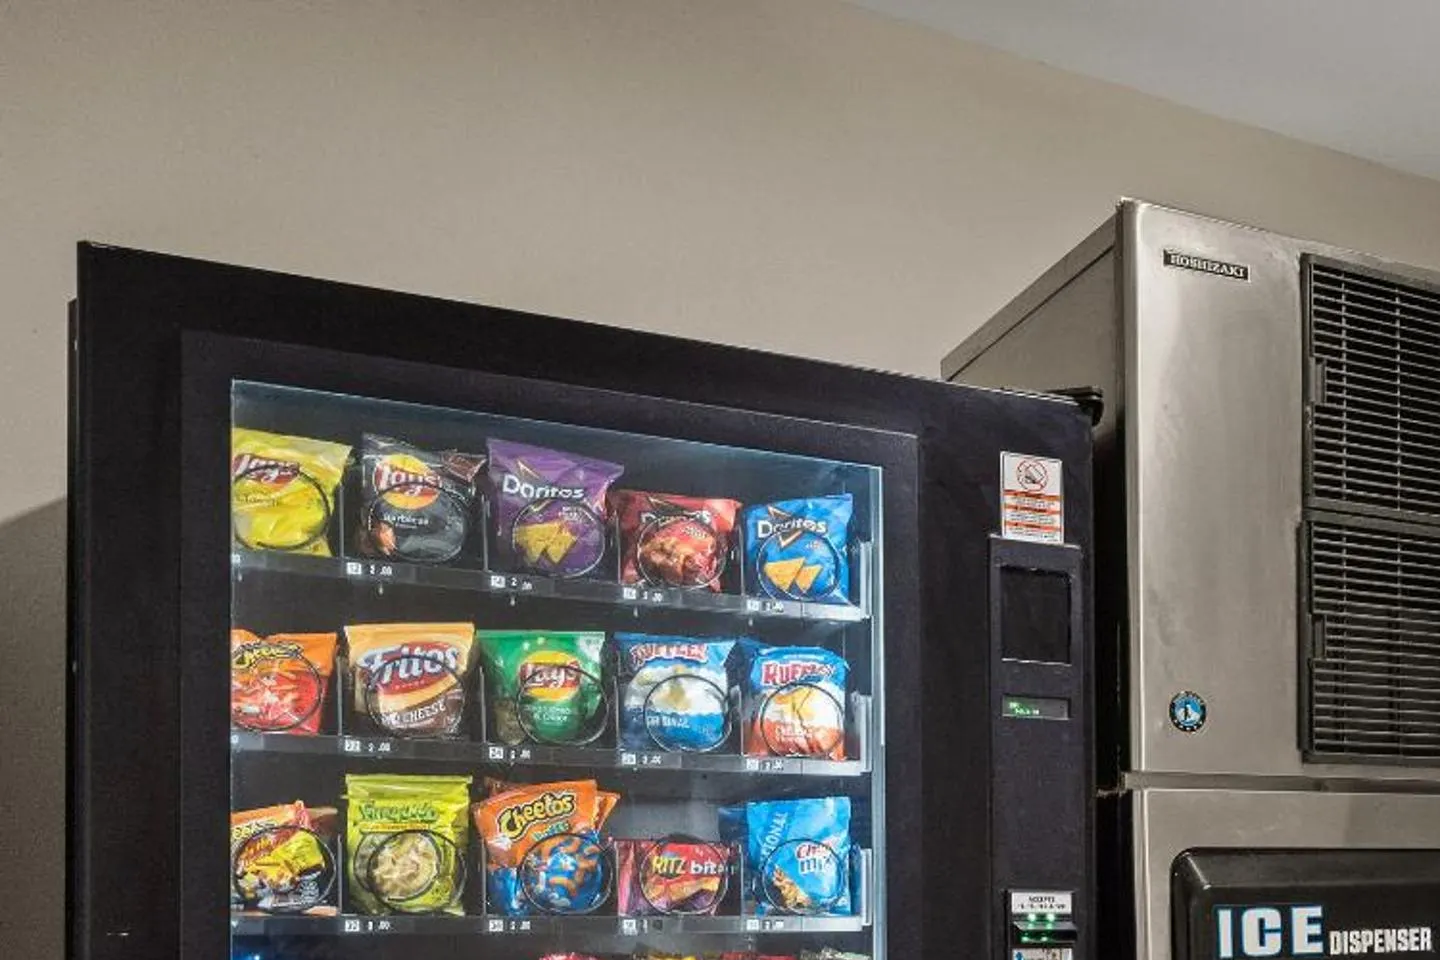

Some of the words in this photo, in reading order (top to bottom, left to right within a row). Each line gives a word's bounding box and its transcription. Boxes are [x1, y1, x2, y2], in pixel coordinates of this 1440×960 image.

[502, 474, 584, 499] Doritos
[758, 518, 827, 539] Doritos
[357, 645, 459, 685] Fritos
[500, 792, 575, 840] Cheetos
[651, 855, 686, 876] RITZ
[1218, 905, 1323, 958] ICE
[1329, 926, 1432, 955] DISPENSER
